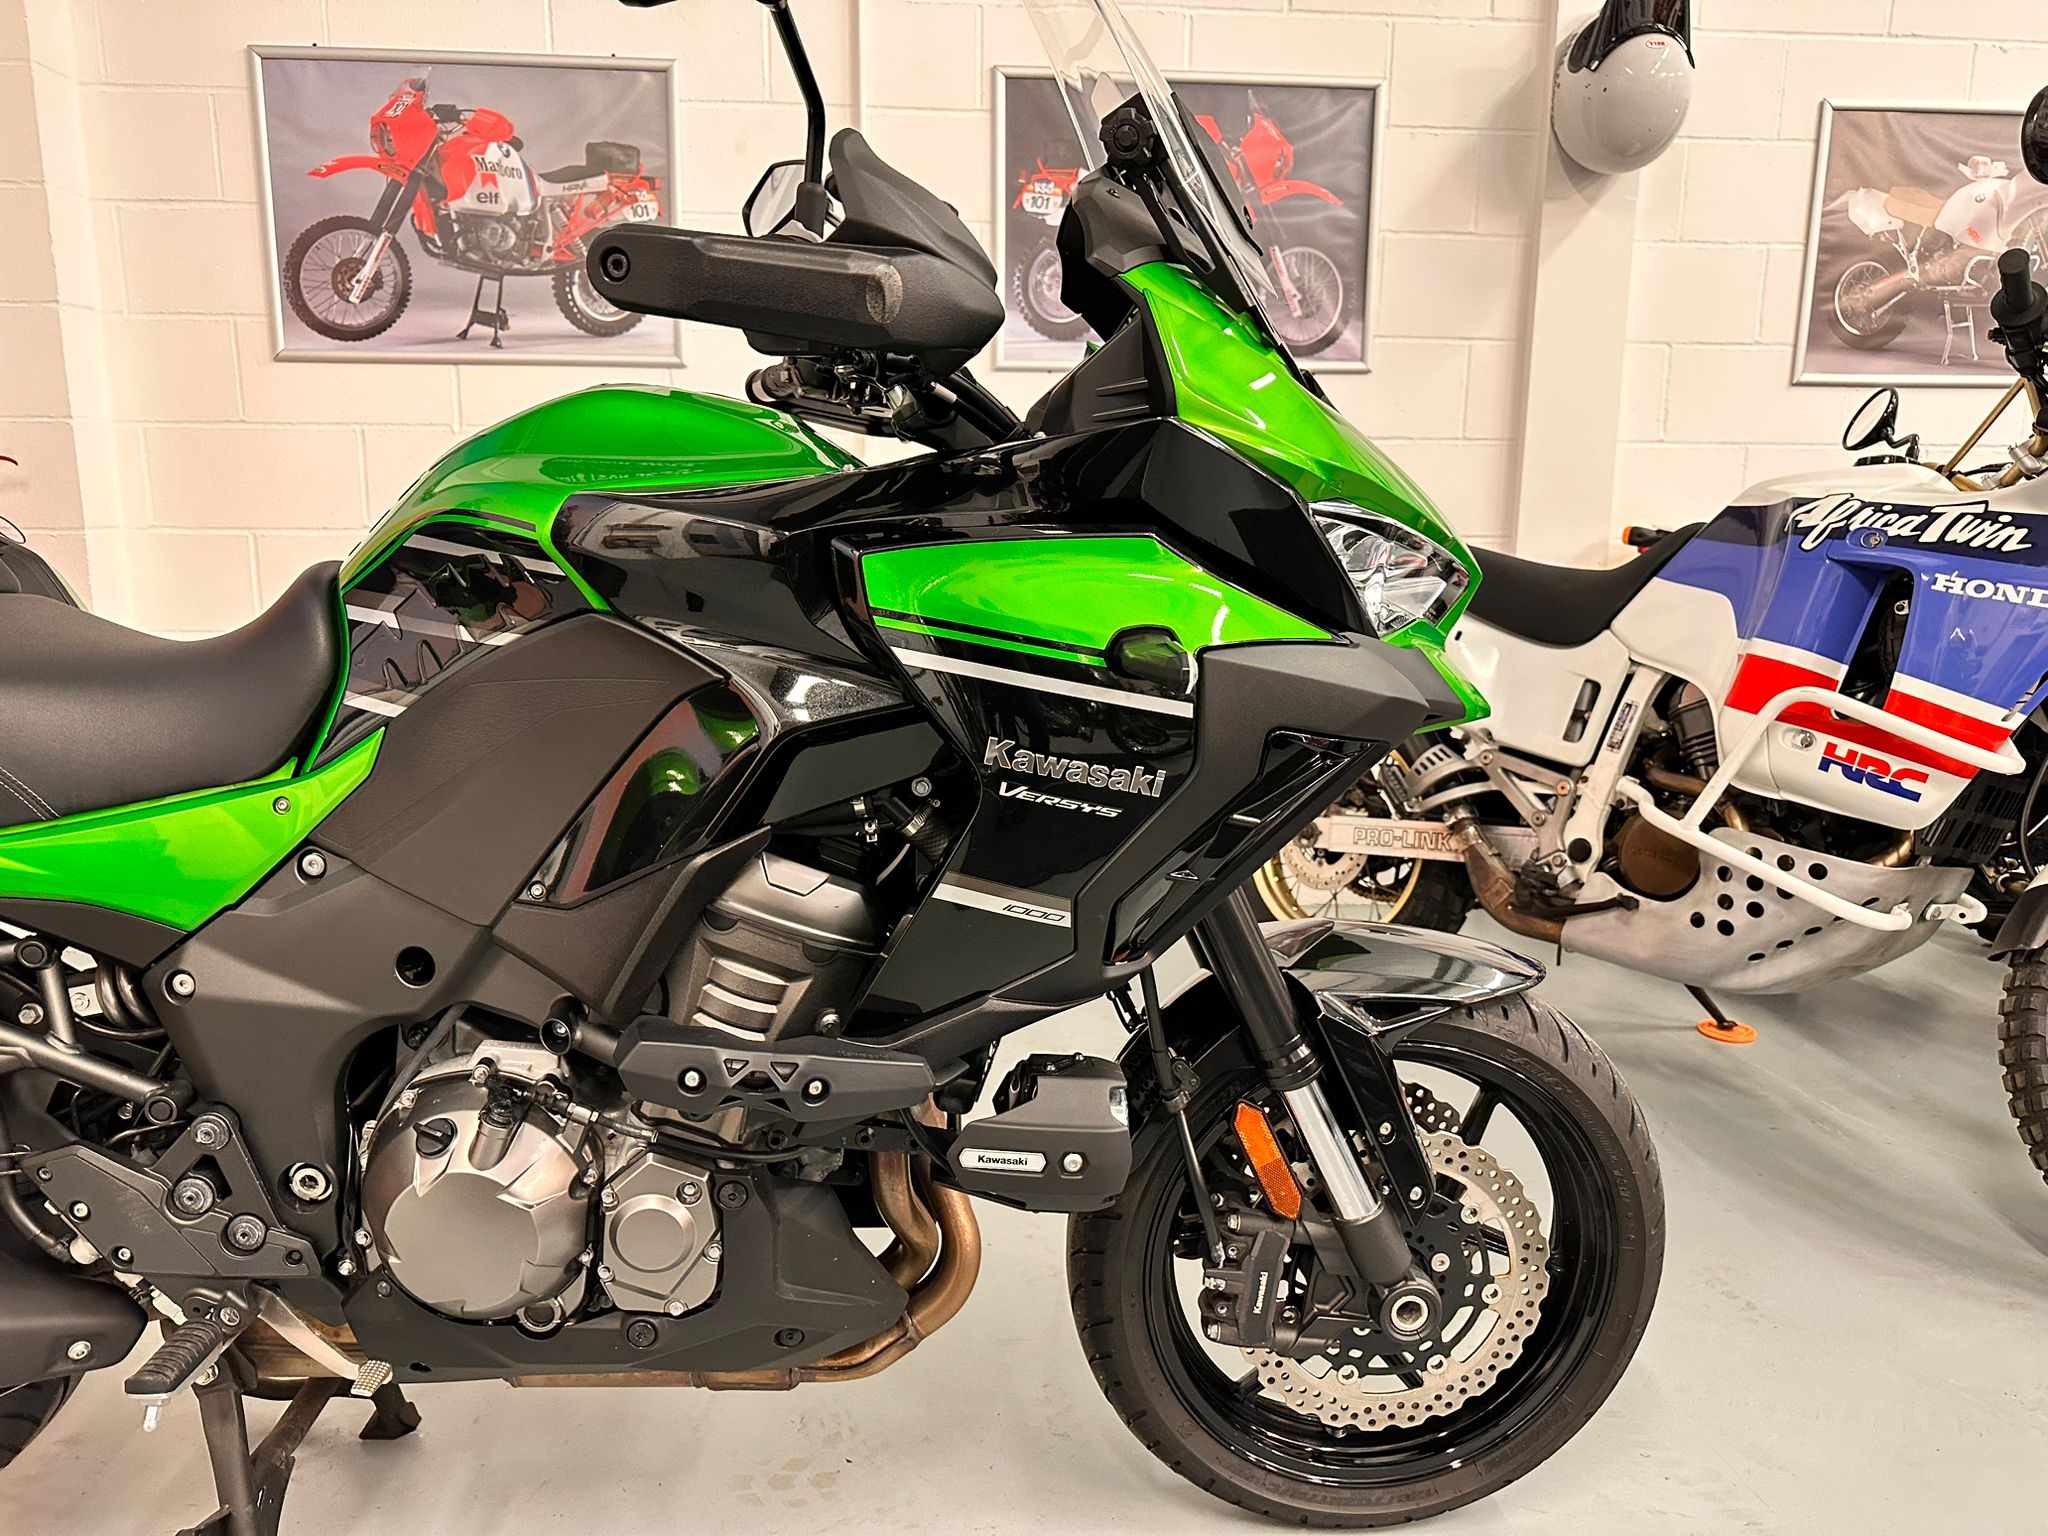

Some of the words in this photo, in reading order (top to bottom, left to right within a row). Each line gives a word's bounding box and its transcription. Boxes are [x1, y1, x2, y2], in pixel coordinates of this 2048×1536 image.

[476, 191, 499, 204] elf
[1031, 195, 1050, 209] 101
[630, 204, 650, 218] 101
[1785, 494, 1928, 550] Africa
[1918, 503, 2032, 551] Twin
[983, 736, 1167, 797] Kawasaki
[1818, 741, 1930, 803] HRC
[999, 781, 1124, 818] VERSYS
[1353, 827, 1453, 851] PRO-LINK
[1002, 904, 1066, 921] 1000
[977, 1154, 1028, 1166] Kawasaki
[1252, 1271, 1269, 1314] Kawasaki
